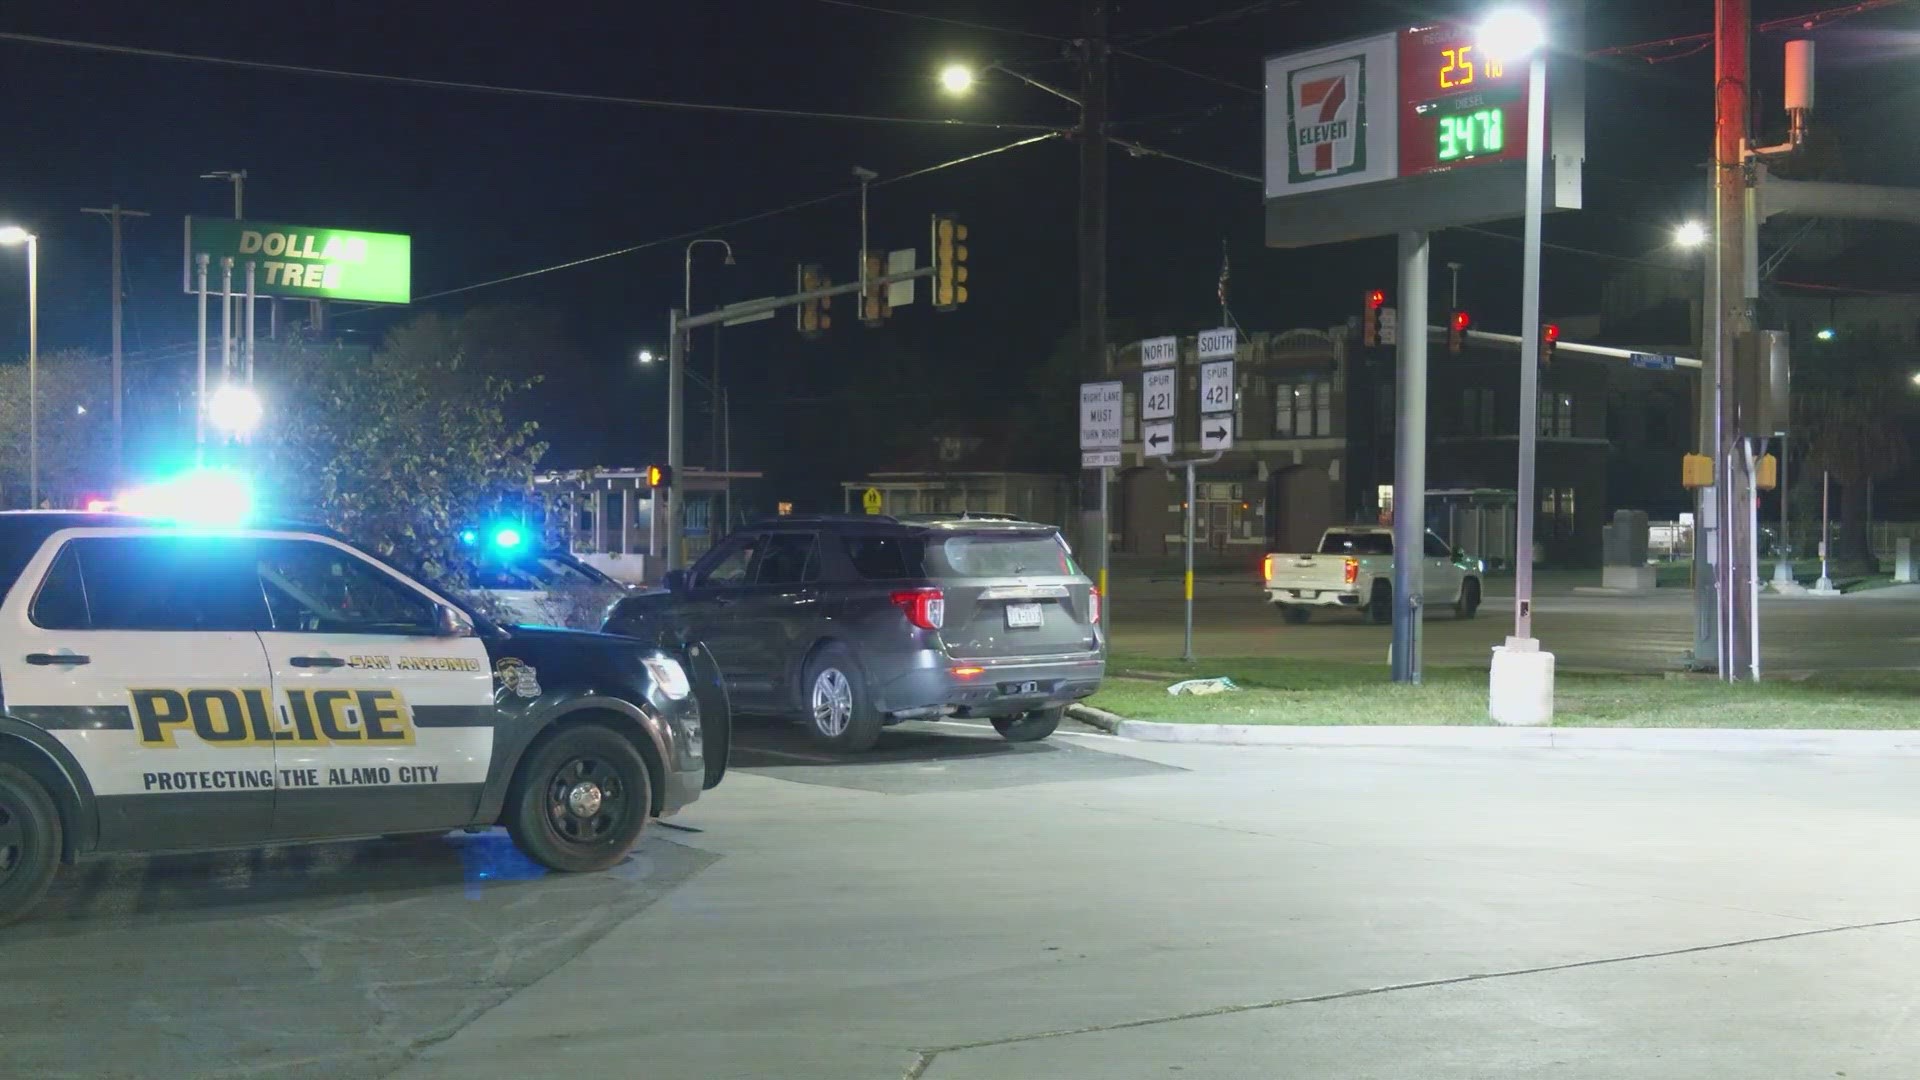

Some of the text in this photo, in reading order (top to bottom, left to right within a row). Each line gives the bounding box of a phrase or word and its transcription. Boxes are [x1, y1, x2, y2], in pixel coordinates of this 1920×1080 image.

[1455, 94, 1484, 110] DIESEL
[1201, 335, 1233, 352] SOUTH
[1144, 344, 1174, 360] NORTH
[1148, 376, 1169, 387] SPUR
[1207, 367, 1228, 380] SPUR
[1083, 391, 1120, 403] RIGHT LANE
[1148, 393, 1170, 410] 421
[1206, 385, 1228, 404] 421
[1090, 410, 1112, 422] MUST
[1083, 428, 1120, 440] TURN RIGHT
[348, 656, 480, 672] SAN ANTONIO
[129, 688, 415, 748] POLICE
[144, 765, 440, 791] PROTECTING THE ALAMO CITY
